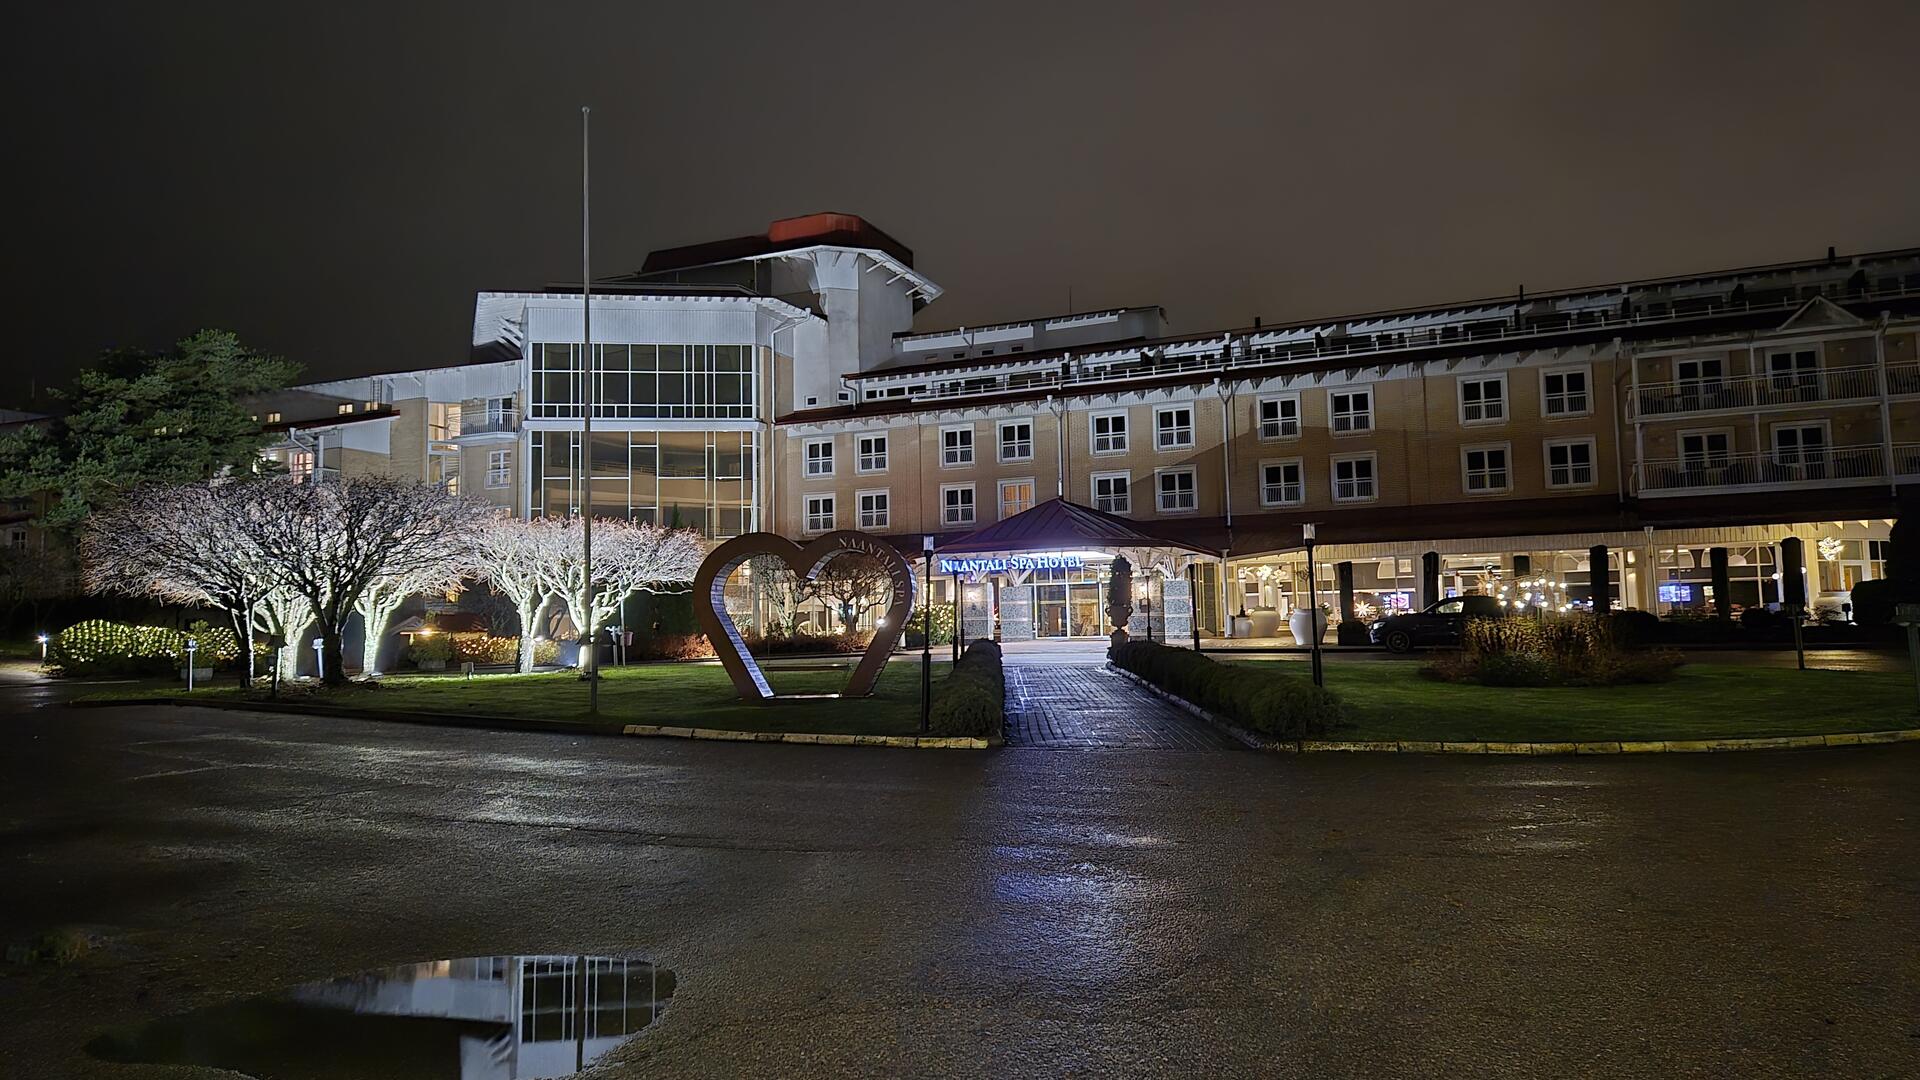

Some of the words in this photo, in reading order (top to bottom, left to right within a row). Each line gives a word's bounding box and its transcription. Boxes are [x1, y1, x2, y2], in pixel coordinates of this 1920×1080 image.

[839, 536, 901, 576] NAANTALI
[895, 580, 905, 606] SPA
[1010, 554, 1035, 570] SPA
[1037, 554, 1084, 569] HOTEL
